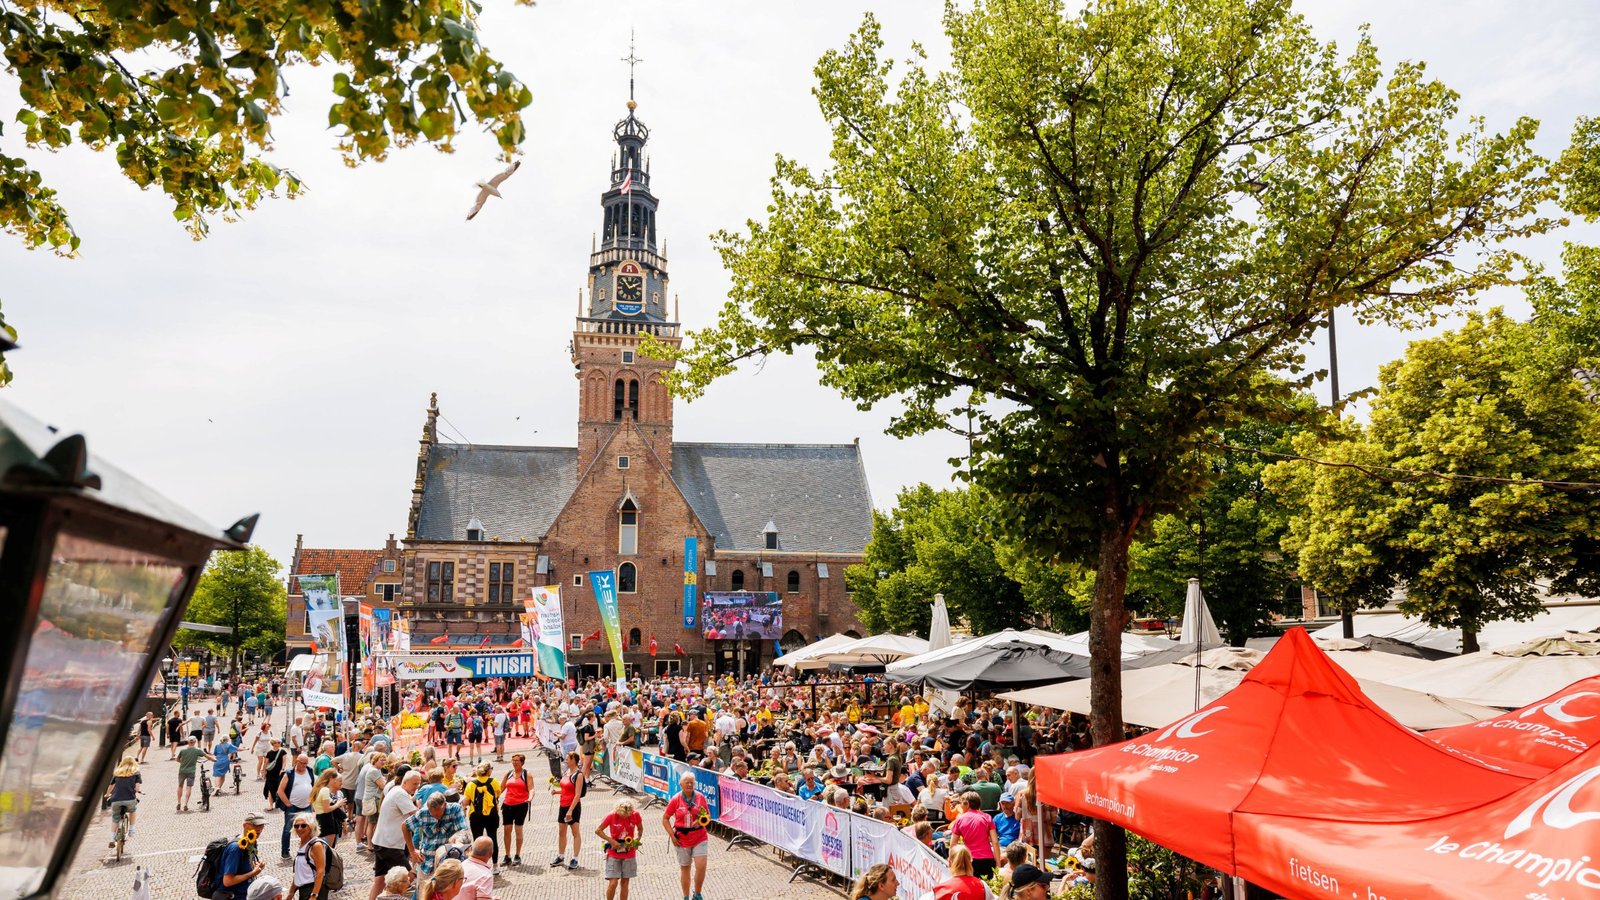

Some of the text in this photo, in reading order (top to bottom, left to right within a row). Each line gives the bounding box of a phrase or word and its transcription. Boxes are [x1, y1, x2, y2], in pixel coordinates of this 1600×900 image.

[476, 656, 530, 675] FINISH
[1120, 742, 1199, 763] le Champion
[1084, 790, 1135, 818] lechampion.nl
[1288, 857, 1339, 894] fietsen
[1424, 835, 1600, 889] le Champio
